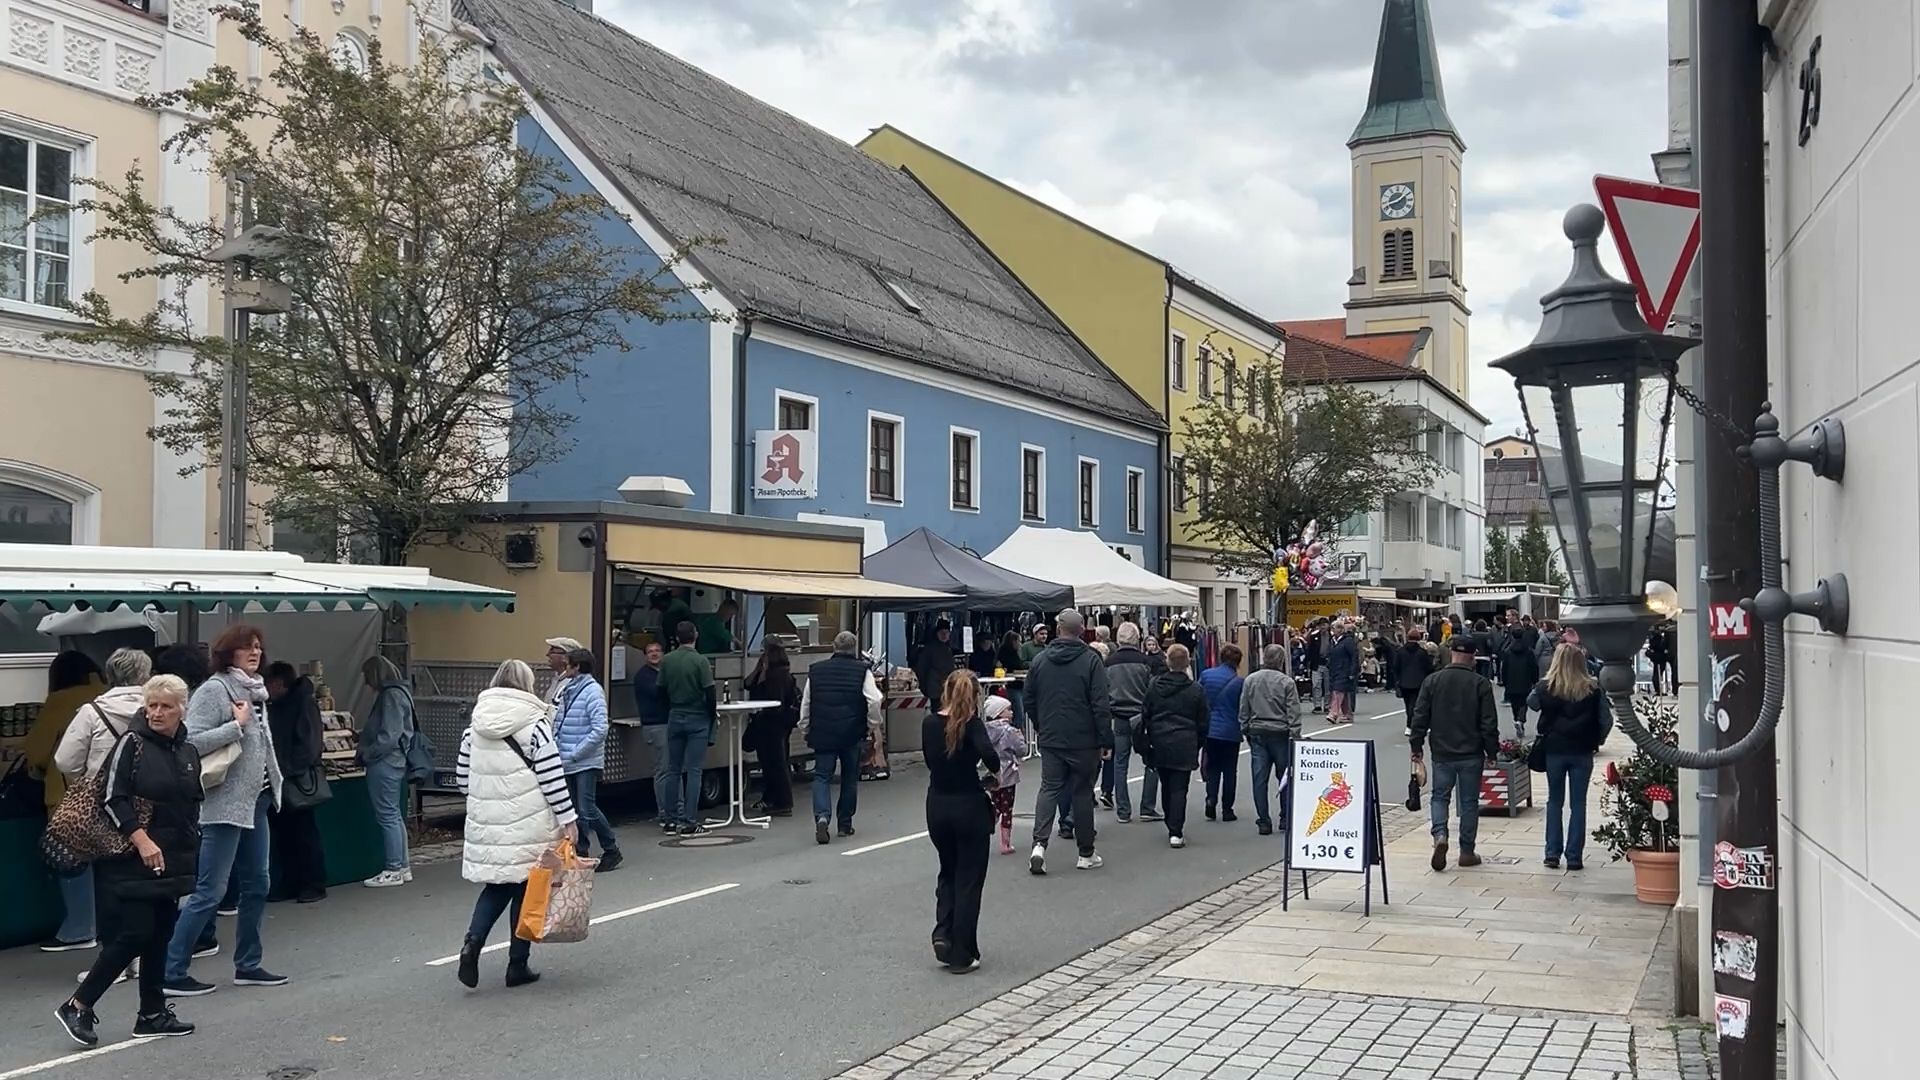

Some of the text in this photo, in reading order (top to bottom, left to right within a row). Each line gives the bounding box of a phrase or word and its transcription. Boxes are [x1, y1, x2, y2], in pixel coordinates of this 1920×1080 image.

[1798, 34, 1821, 148] 25
[757, 487, 807, 497] Asam Apotheke
[1347, 558, 1357, 571] P
[1287, 597, 1352, 606] ellnessbäckerei
[1287, 607, 1321, 616] chreiner
[1300, 746, 1340, 756] Feinstes
[1300, 759, 1348, 769] Konditor-
[1300, 772, 1314, 782] Eis
[1332, 828, 1359, 839] Kugel
[1301, 844, 1355, 860] 1,30 €
